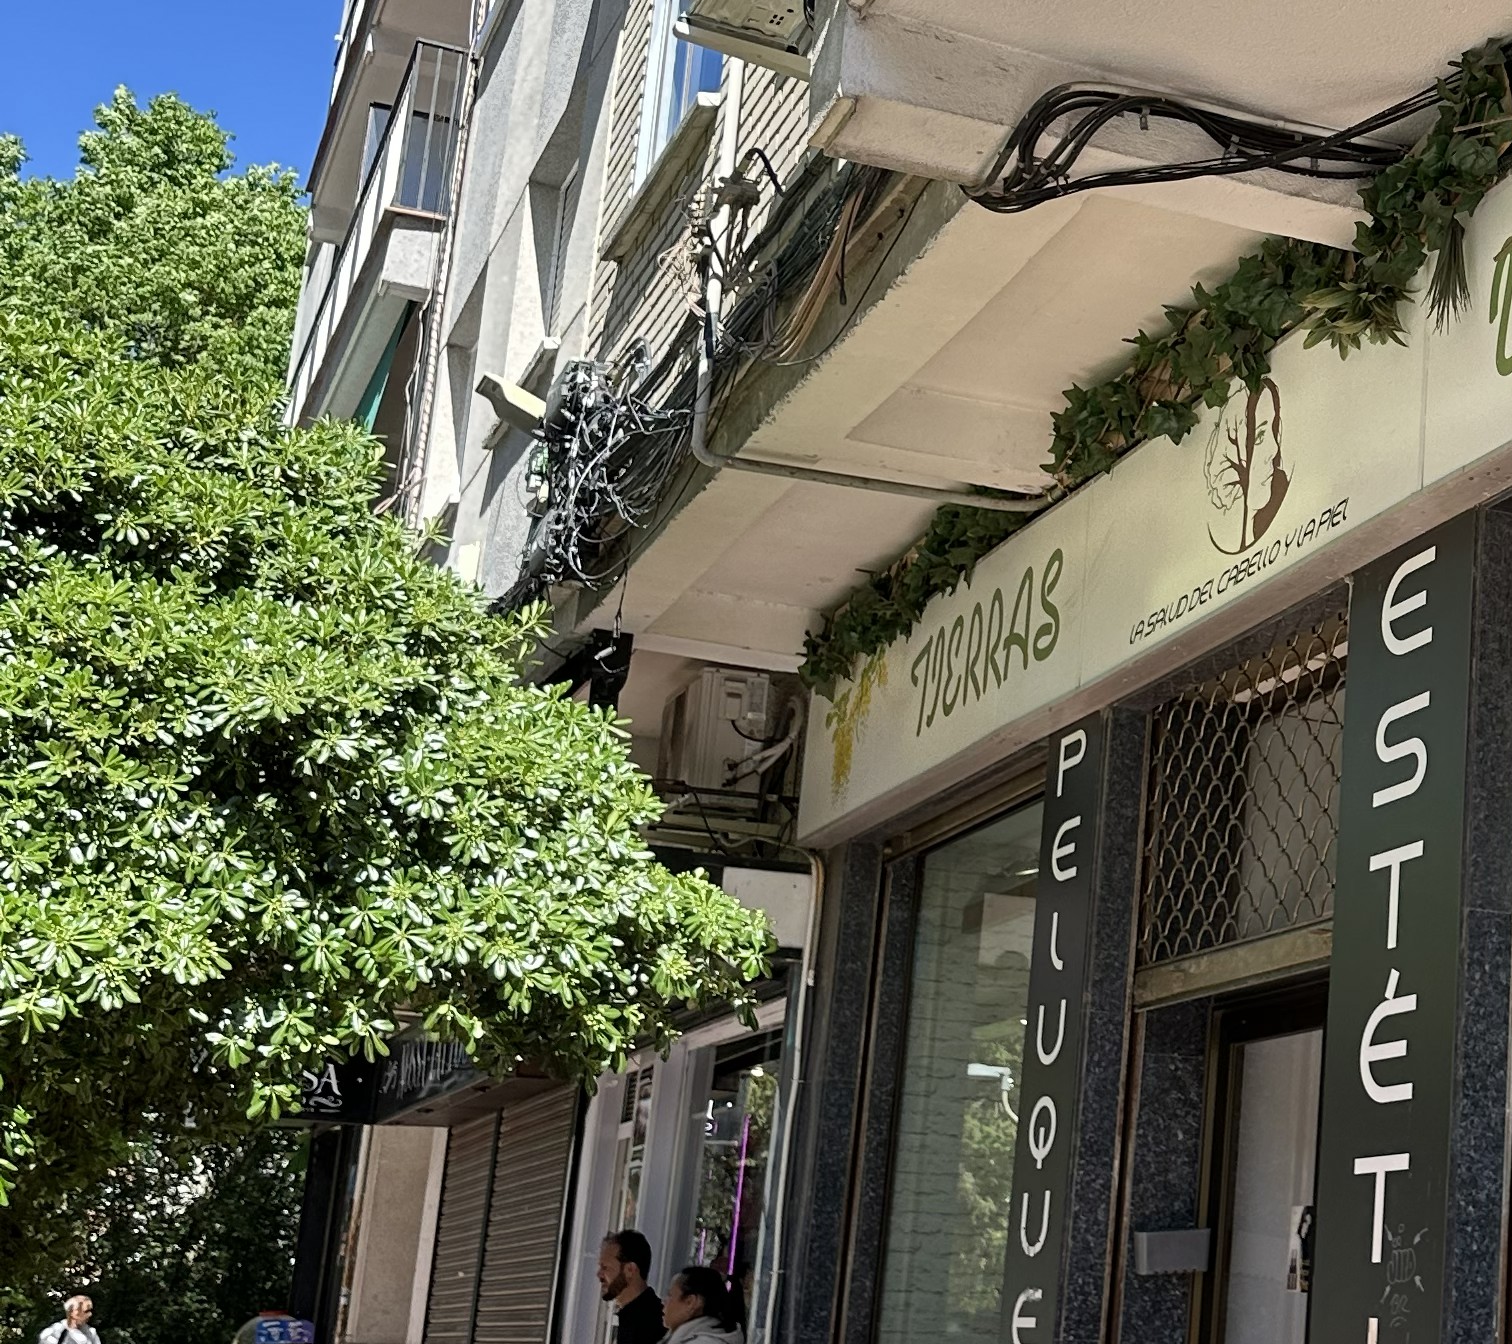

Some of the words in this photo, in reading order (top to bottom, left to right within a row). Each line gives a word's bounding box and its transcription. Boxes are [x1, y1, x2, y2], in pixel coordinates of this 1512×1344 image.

[911, 548, 1063, 737] TIERRAS
[1129, 620, 1145, 645] LA
[1144, 594, 1189, 638] SALUD
[1188, 578, 1215, 613] DEL
[1217, 539, 1281, 595] CABELLO
[1284, 528, 1297, 556] Y
[1297, 518, 1316, 548] LA
[1315, 497, 1350, 538] PIEL
